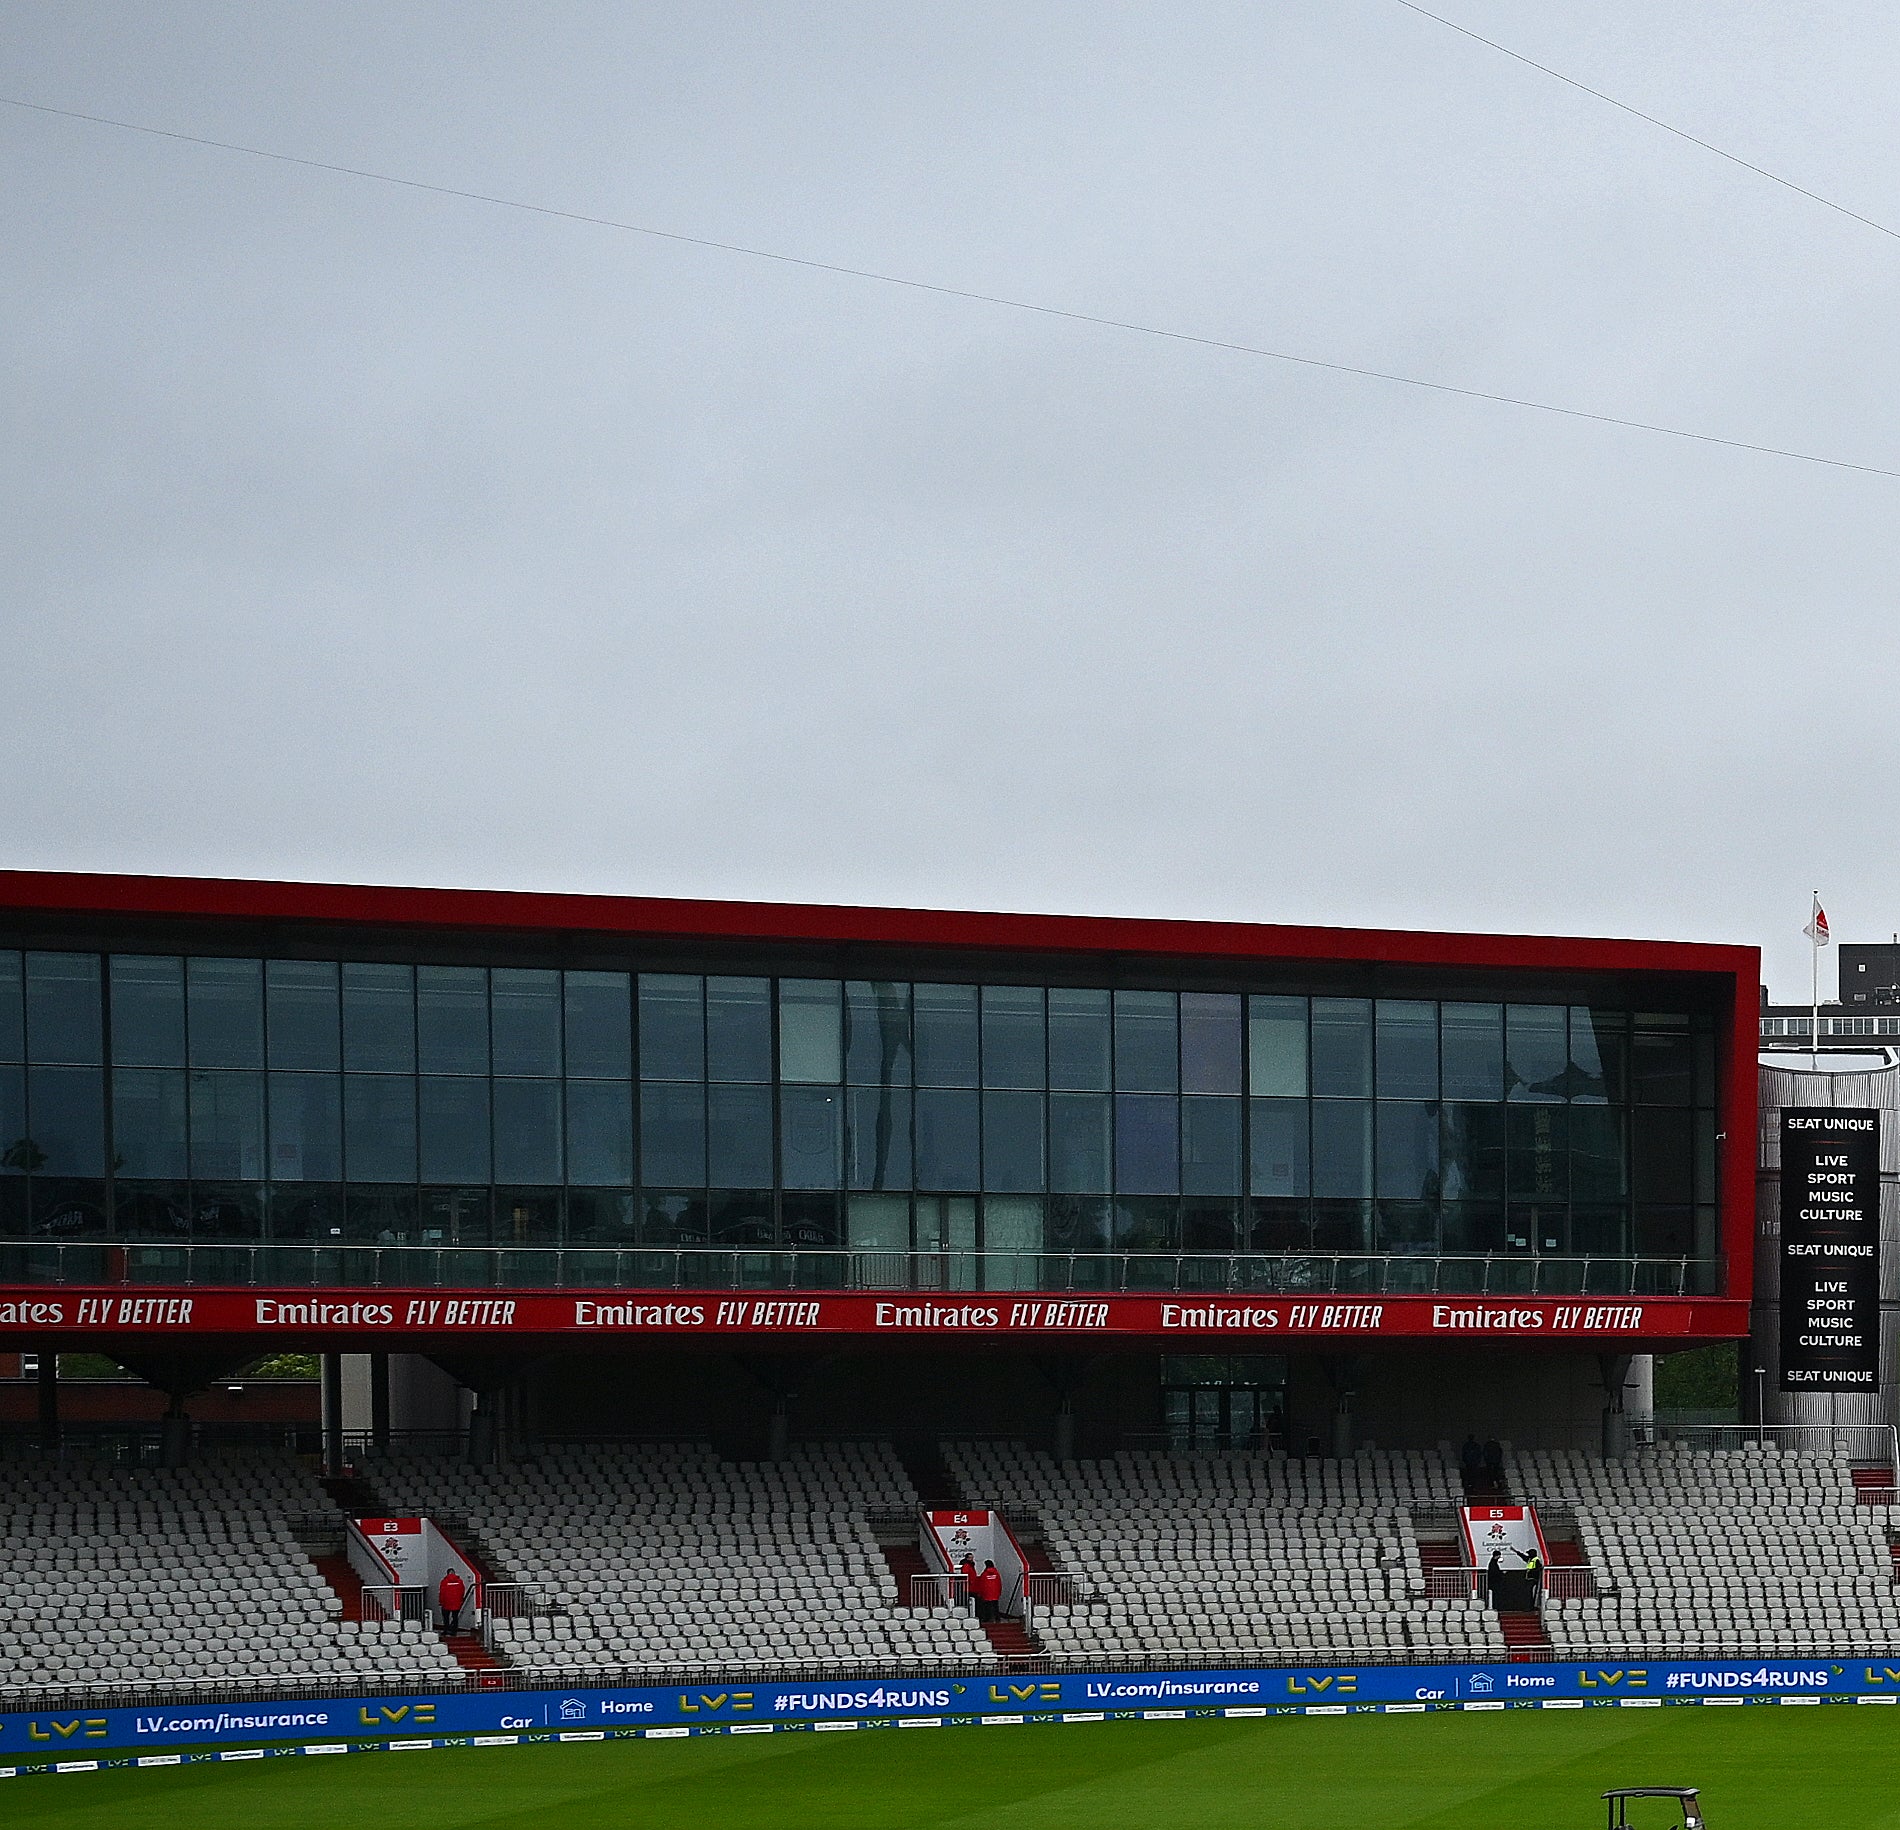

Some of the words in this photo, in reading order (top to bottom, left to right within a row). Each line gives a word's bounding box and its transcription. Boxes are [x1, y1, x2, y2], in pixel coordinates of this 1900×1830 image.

[1788, 1119, 1821, 1130] SEAT
[1824, 1119, 1874, 1131] UNIQUE
[1815, 1155, 1848, 1167] LIVE
[1807, 1174, 1856, 1185] SPORT
[1808, 1191, 1854, 1202] MUSIC
[1799, 1209, 1863, 1221] CULTURE
[1788, 1244, 1821, 1256] SEAT
[1824, 1244, 1874, 1257] UNIQUE
[1815, 1281, 1848, 1292] LIVE
[1806, 1299, 1855, 1310] SPORT
[77, 1299, 113, 1323] FLY
[118, 1299, 193, 1323] BETTER
[256, 1299, 392, 1324] Emirates
[406, 1300, 442, 1324] FLY
[444, 1300, 516, 1324] BETTER
[576, 1301, 704, 1325] Emirates
[716, 1302, 748, 1325] FLY
[751, 1302, 820, 1325] BETTER
[876, 1303, 998, 1327] Emirates
[1009, 1304, 1042, 1326] FLY
[1044, 1304, 1108, 1327] BETTER
[1162, 1303, 1278, 1328] Emirates
[1289, 1304, 1320, 1328] FLY
[1321, 1305, 1383, 1328] BETTER
[1433, 1305, 1543, 1329] Emirates
[1551, 1306, 1582, 1329] FLY
[1584, 1306, 1643, 1329] BETTER
[1808, 1317, 1853, 1328] MUSIC
[1799, 1335, 1862, 1347] CULTURE
[1787, 1371, 1821, 1382] SEAT
[1823, 1371, 1873, 1383] UNIQUE
[954, 1514, 968, 1523] E4
[1489, 1509, 1504, 1518] E5
[383, 1522, 398, 1532] E3
[1666, 1667, 1829, 1688] #FUNDS4RUNS
[1086, 1680, 1260, 1699] LV.com/insurance
[1415, 1687, 1445, 1700] Car
[1507, 1674, 1555, 1687] Home
[774, 1687, 950, 1712] #FUNDS4RUNS
[500, 1716, 533, 1729] Car
[601, 1700, 654, 1714] Home
[135, 1711, 329, 1734] LV.com/insurance
